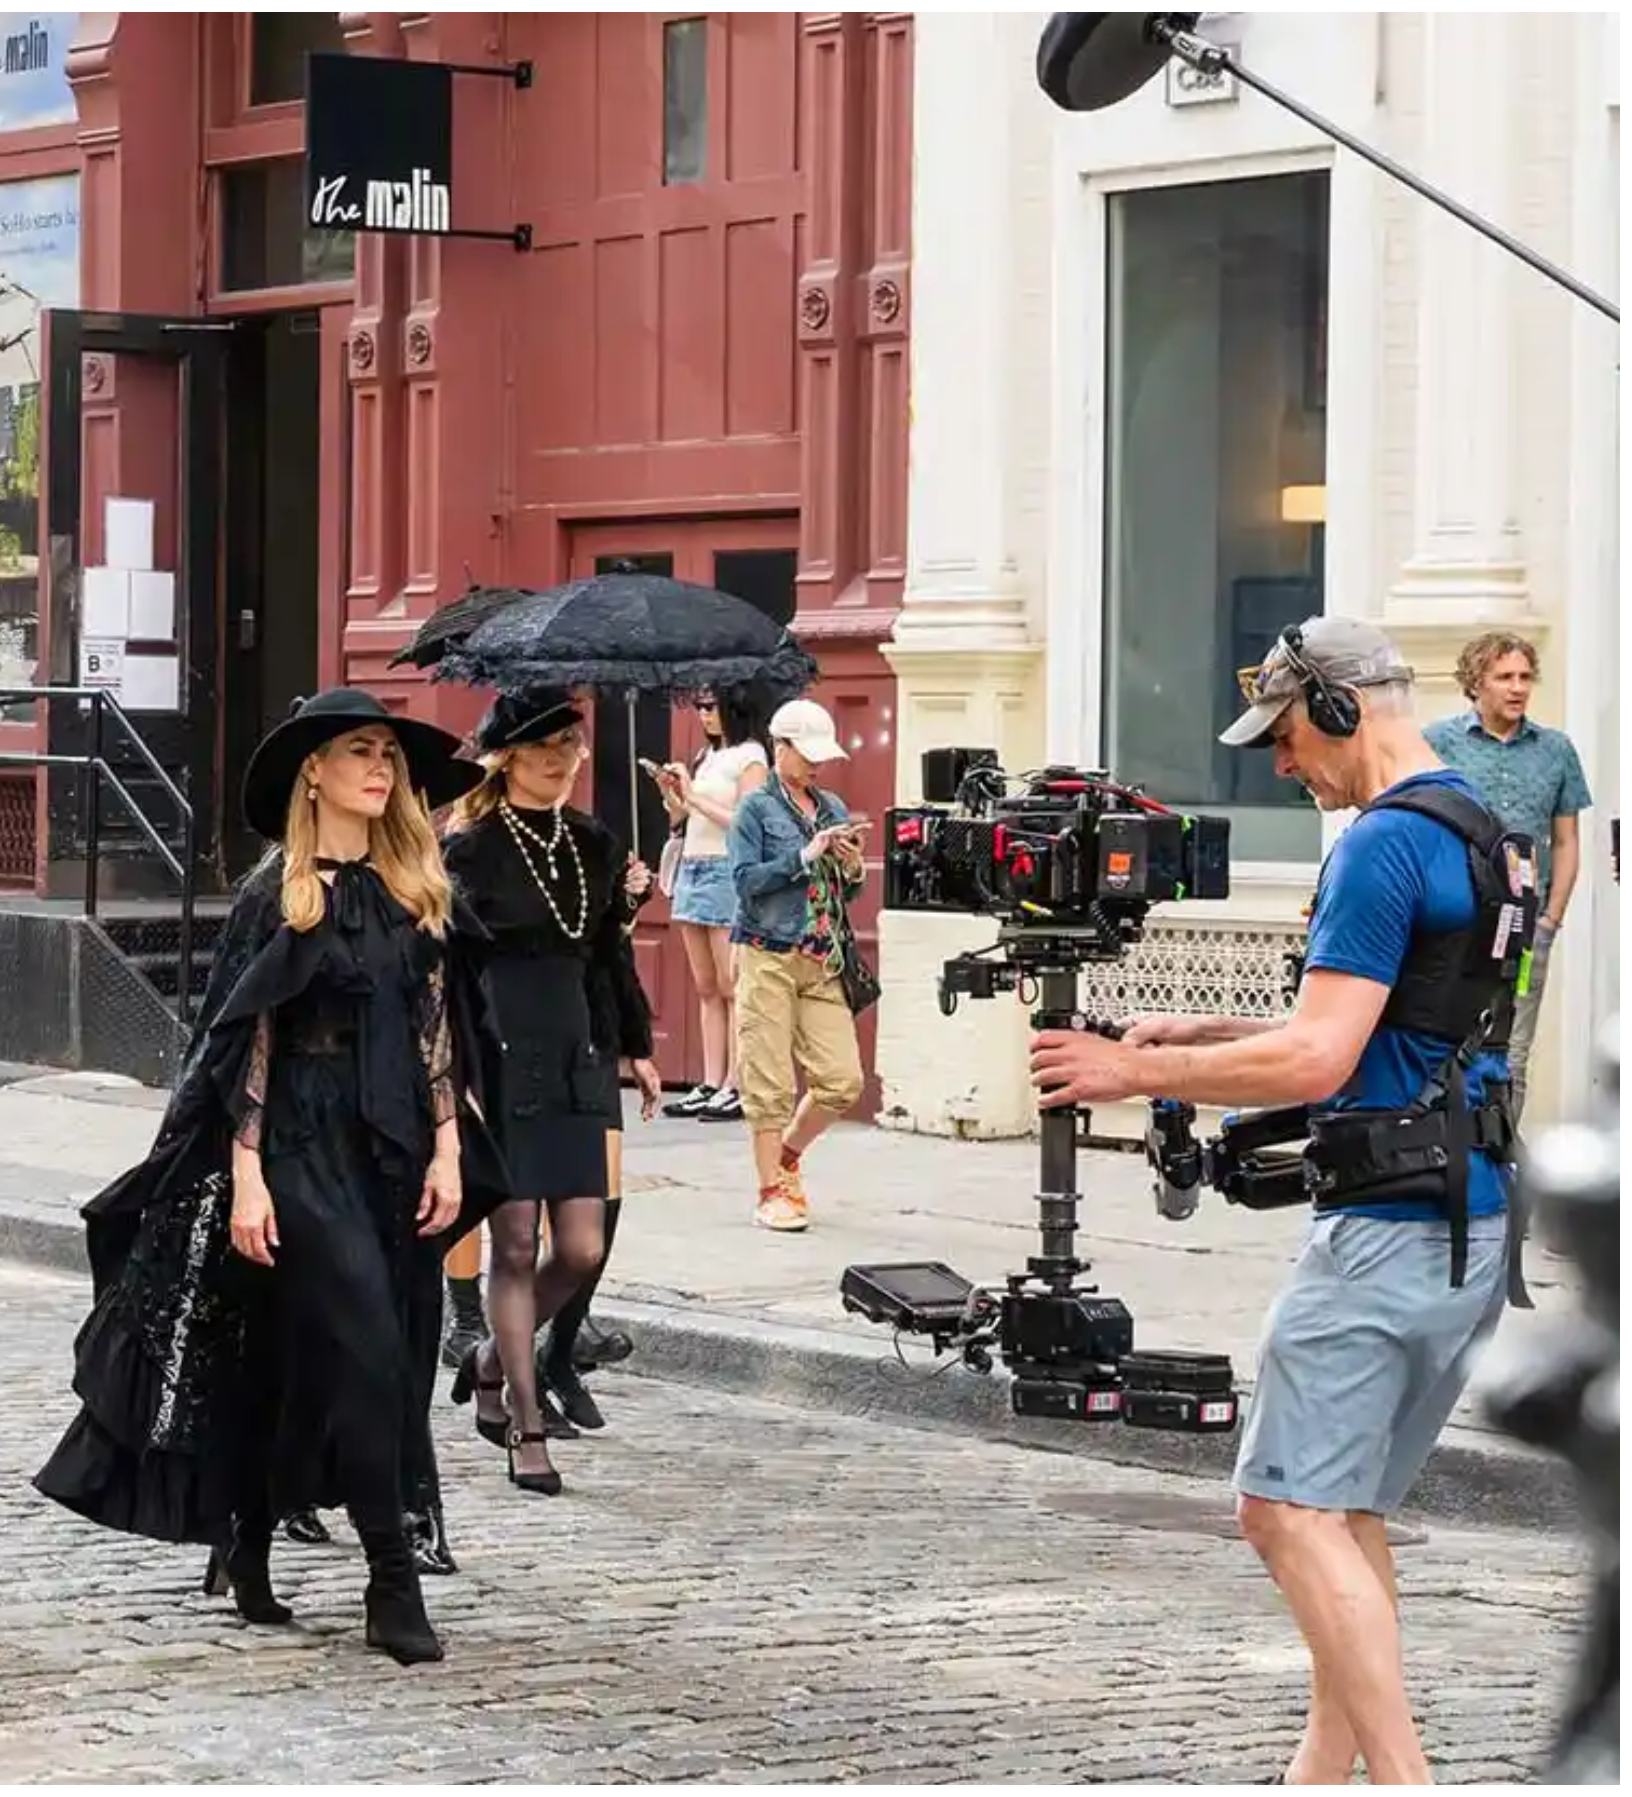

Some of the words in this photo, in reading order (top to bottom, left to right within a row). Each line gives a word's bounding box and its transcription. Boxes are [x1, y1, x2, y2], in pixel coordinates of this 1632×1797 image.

[5, 21, 48, 74] malin
[365, 168, 450, 231] malin
[88, 655, 100, 672] B
